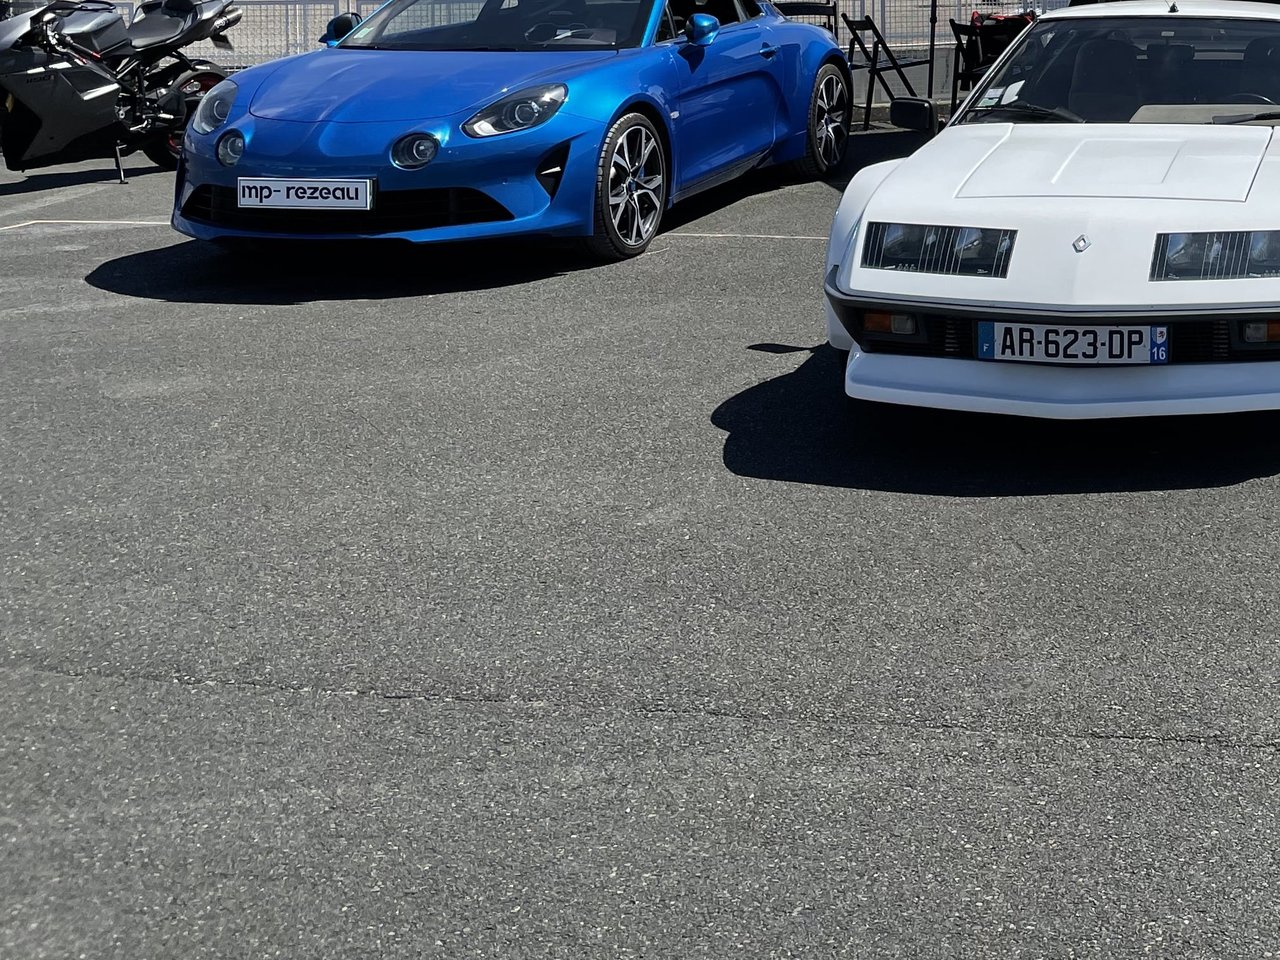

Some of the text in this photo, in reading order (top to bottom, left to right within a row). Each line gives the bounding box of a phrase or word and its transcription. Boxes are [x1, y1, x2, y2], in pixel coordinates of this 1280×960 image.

[983, 326, 1166, 360] F AR-623-DP 16
